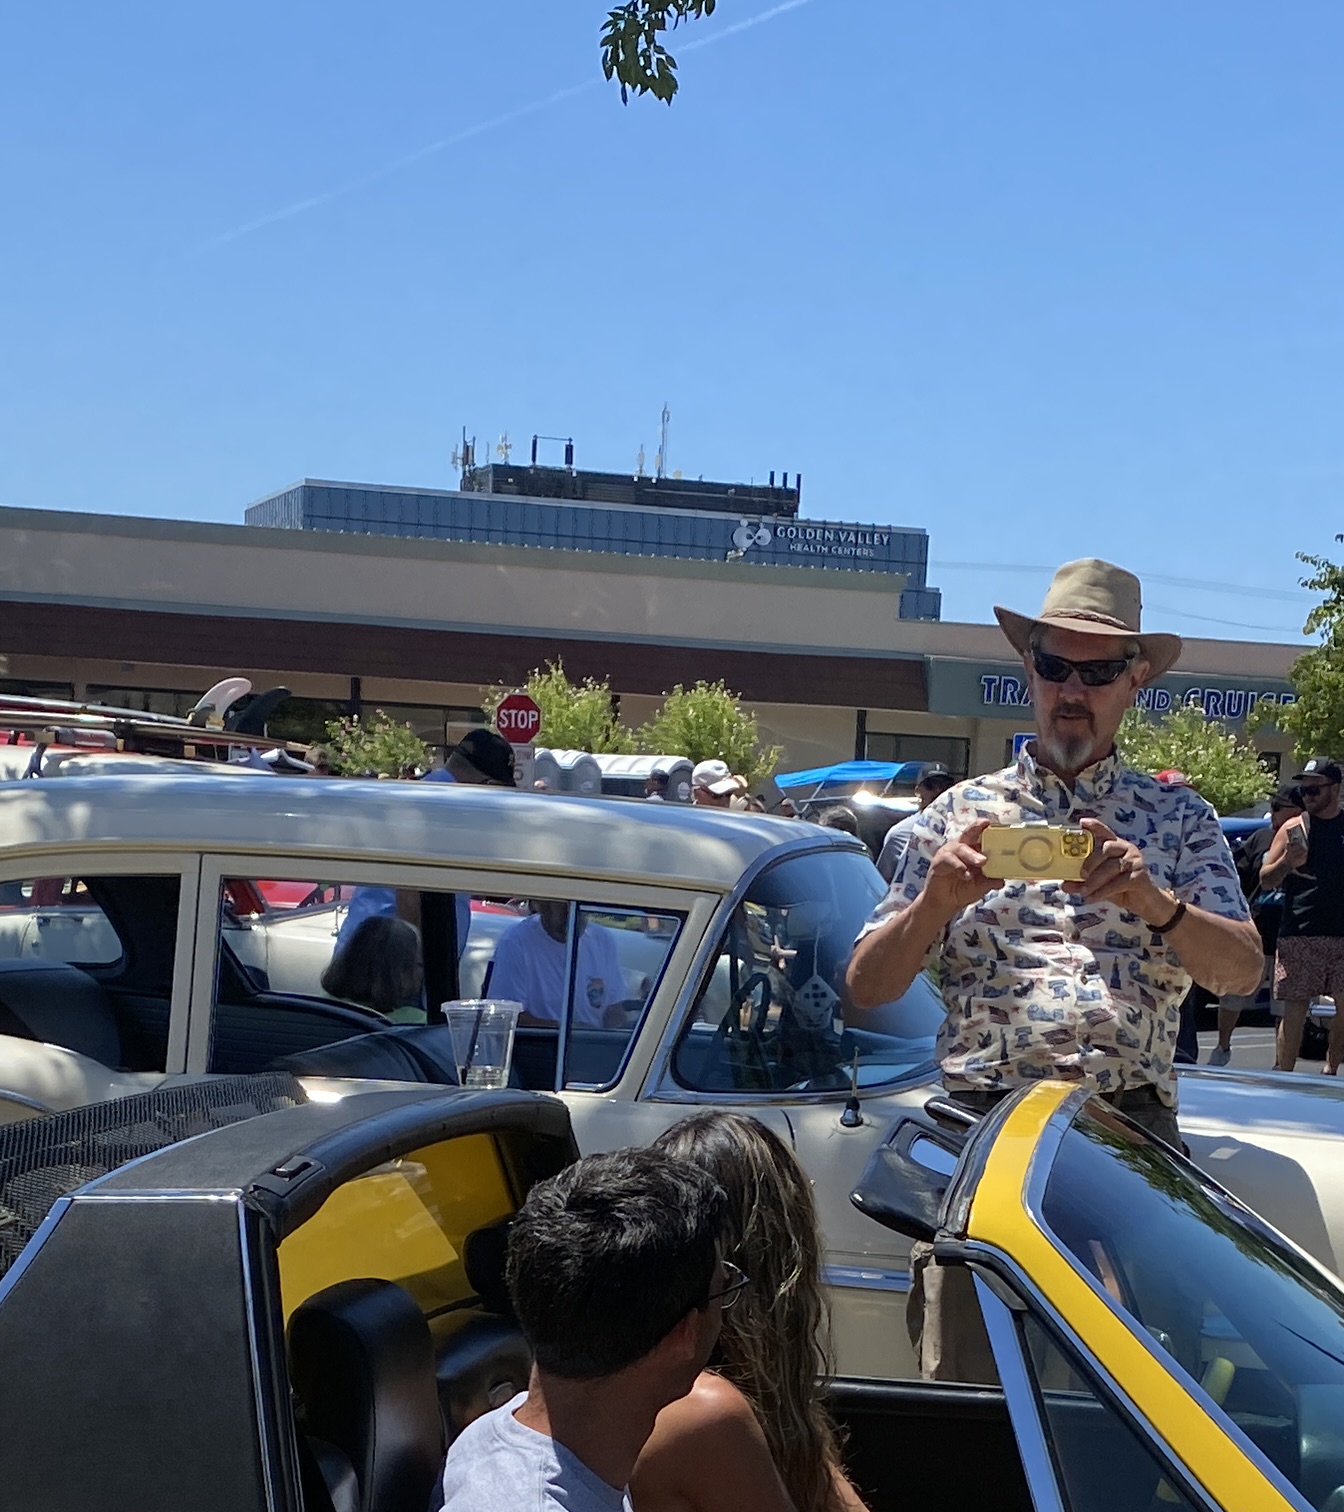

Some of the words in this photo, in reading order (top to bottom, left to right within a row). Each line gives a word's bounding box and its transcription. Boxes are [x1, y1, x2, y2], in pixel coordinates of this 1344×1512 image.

[776, 526, 834, 542] GOLDEN
[839, 531, 890, 546] VALLEY
[790, 543, 828, 553] HEALTH
[831, 546, 875, 557] CENTERS
[499, 709, 538, 729] STOP
